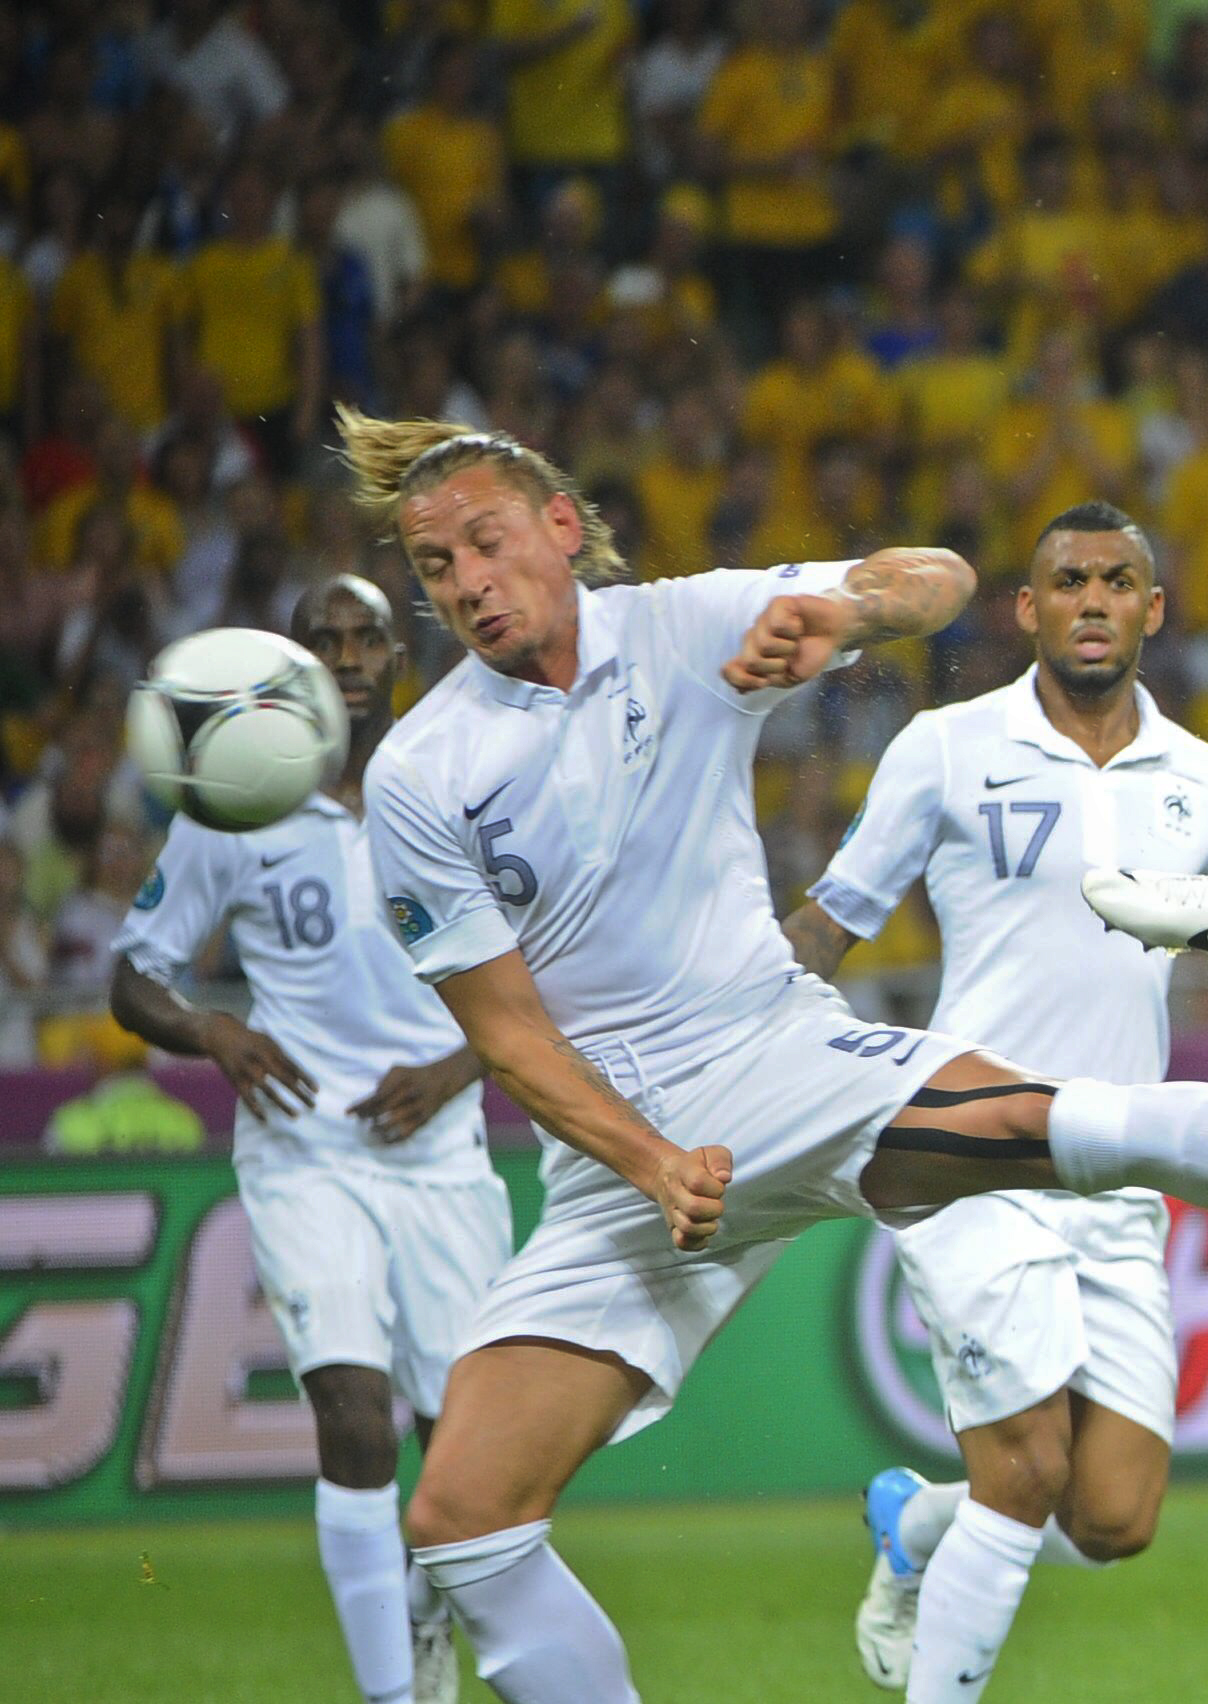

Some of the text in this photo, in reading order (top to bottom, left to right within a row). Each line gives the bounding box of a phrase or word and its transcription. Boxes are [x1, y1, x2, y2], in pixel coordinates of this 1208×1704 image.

[478, 817, 538, 906] 5
[978, 802, 1061, 879] 17
[262, 879, 335, 949] 18
[826, 1030, 906, 1057] 5
